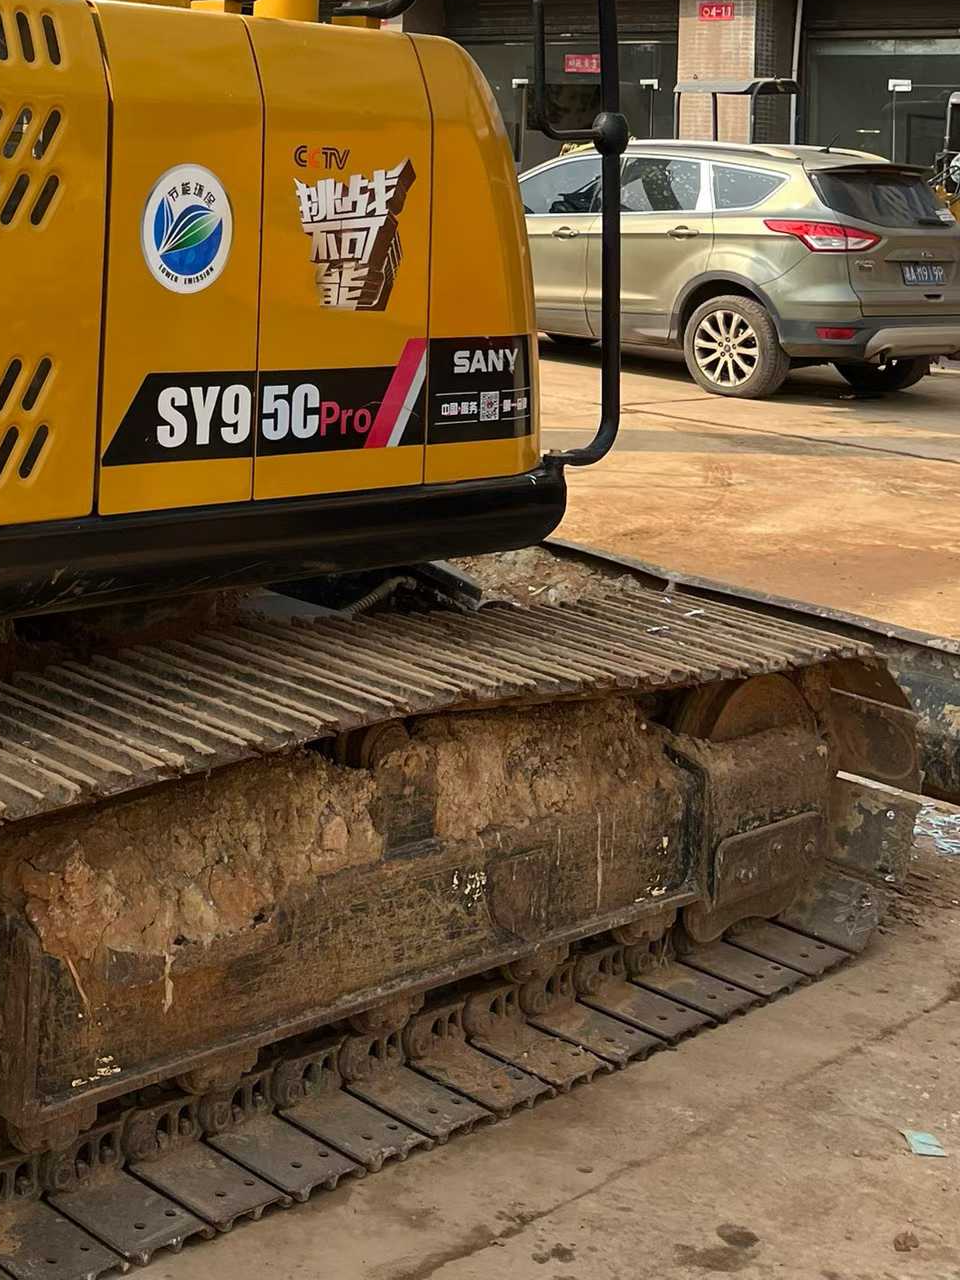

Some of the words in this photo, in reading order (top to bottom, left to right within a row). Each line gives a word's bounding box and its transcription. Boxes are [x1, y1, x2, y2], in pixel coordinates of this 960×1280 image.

[294, 145, 351, 170] CCTV
[293, 158, 410, 222] 挑战
[303, 215, 388, 265] 不可
[315, 261, 370, 311] 能
[454, 348, 518, 374] SANY
[156, 382, 321, 449] SY95C
[320, 400, 372, 437] Pro
